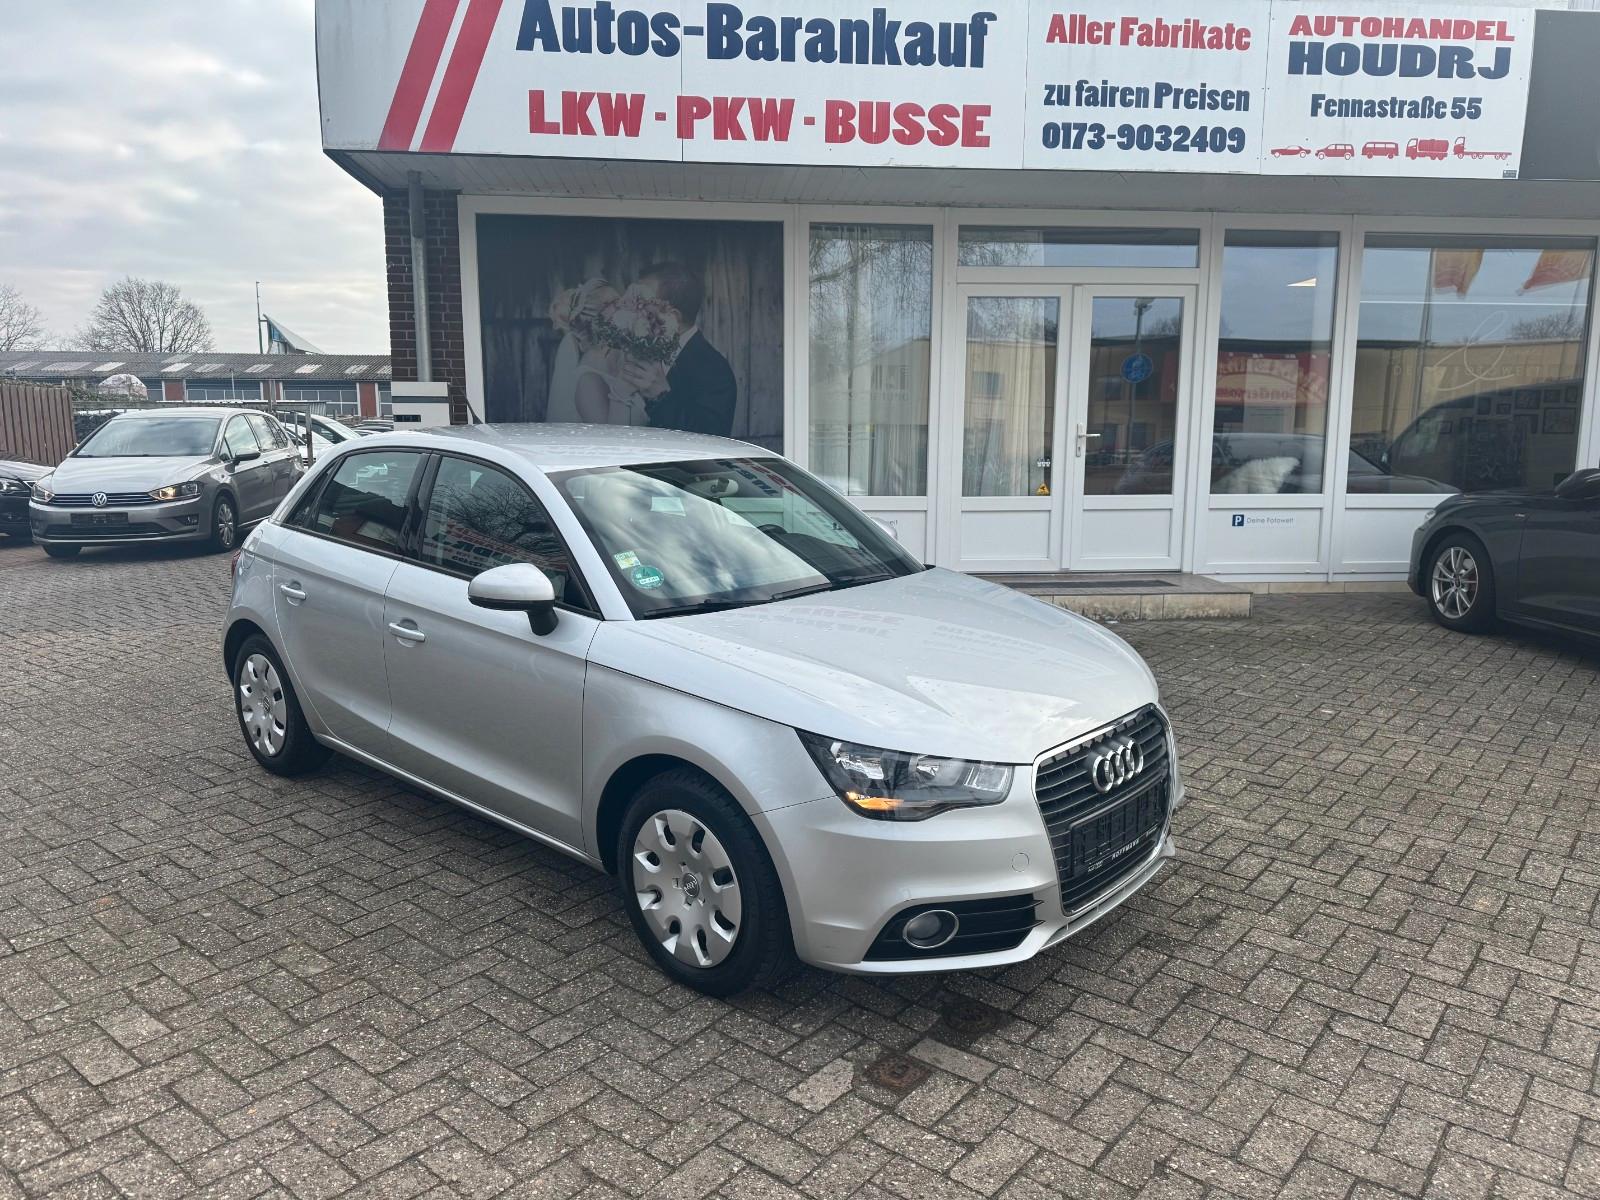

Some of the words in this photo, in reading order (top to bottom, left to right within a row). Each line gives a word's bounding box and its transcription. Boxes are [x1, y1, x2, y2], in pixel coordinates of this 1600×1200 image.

[516, 0, 997, 68] Autos-Barankauf
[1046, 14, 1115, 46] Aller
[1119, 17, 1251, 51] Fabrikate
[1288, 15, 1515, 41] AUTOHANDEL
[1288, 41, 1512, 79] HOUDRJ
[1043, 84, 1071, 106] zu
[1075, 80, 1149, 108] fairen
[1154, 82, 1250, 111] Preisen
[1310, 94, 1447, 119] Fennastraße
[1450, 97, 1483, 120] 55
[528, 90, 646, 137] LKW
[676, 95, 795, 142] PKW
[825, 100, 991, 147] BUSSE
[1042, 122, 1246, 153] 0173-9032409
